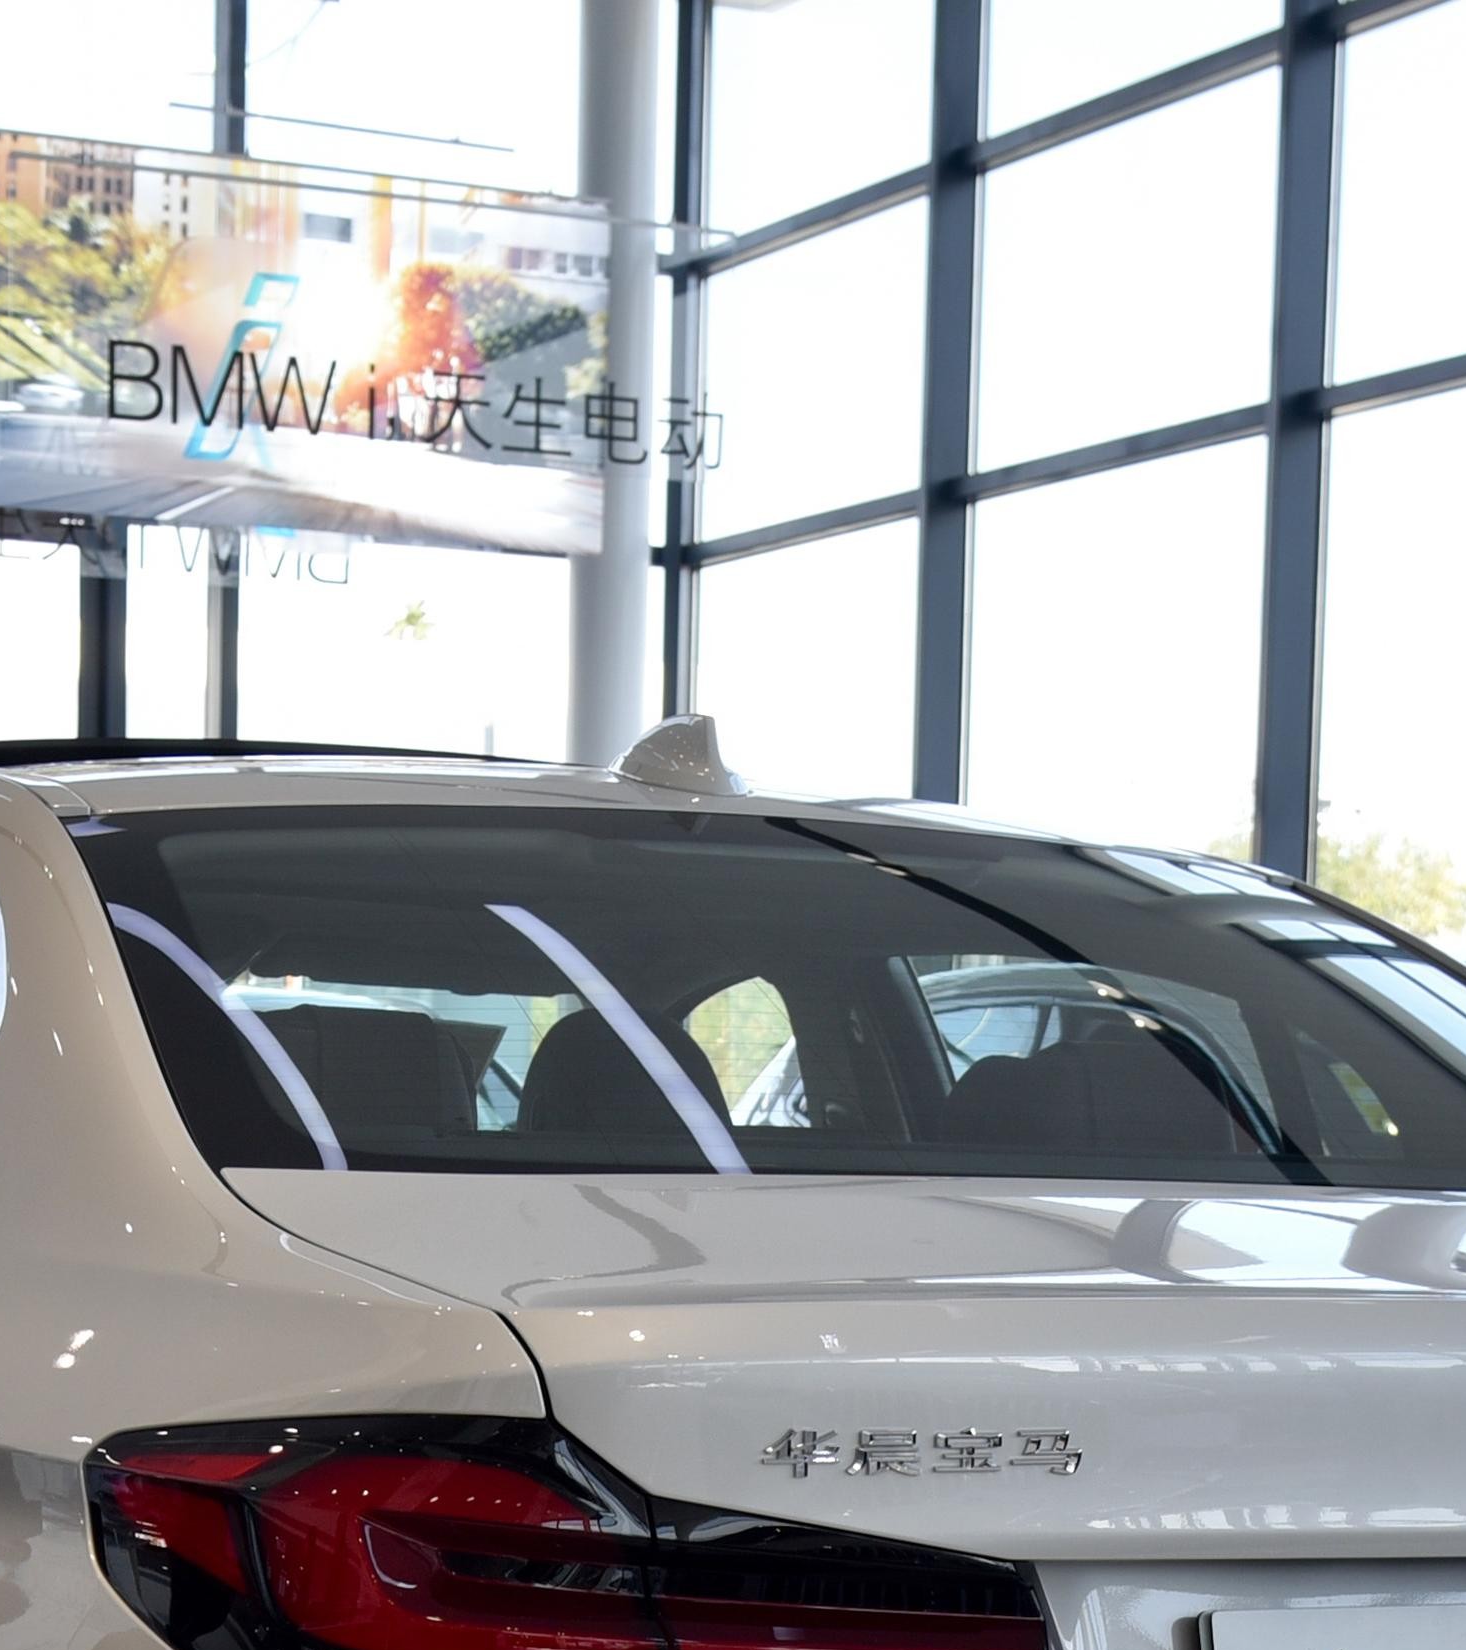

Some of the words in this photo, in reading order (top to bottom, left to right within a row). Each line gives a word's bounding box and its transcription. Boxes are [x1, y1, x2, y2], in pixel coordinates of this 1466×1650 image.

[107, 339, 337, 436] BMW
[760, 1426, 1084, 1479] 华晨宝马
